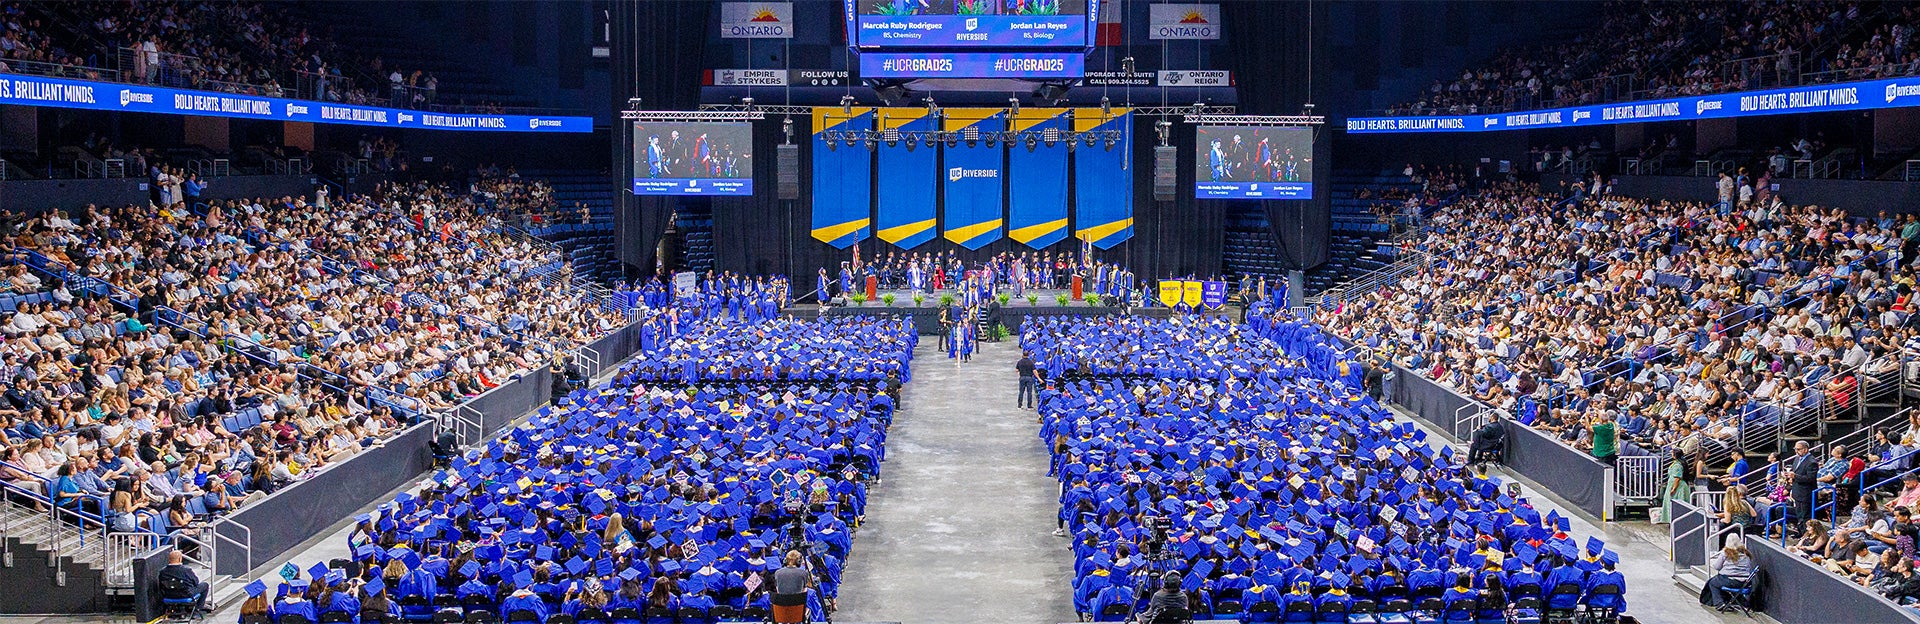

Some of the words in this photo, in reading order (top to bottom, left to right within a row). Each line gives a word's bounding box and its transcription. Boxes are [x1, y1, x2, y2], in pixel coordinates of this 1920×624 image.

[731, 26, 783, 35] ONTARIO
[890, 22, 908, 31] Ruby
[909, 22, 942, 31] Rodriguez
[1010, 22, 1032, 30] Jordan
[1050, 22, 1067, 31] Reyes
[893, 32, 921, 40] Chemistry
[1033, 32, 1055, 40] Biology
[1159, 27, 1210, 36] ONTARIO
[956, 33, 988, 41] RIVERSIDE
[883, 59, 952, 71] #UCRGRAD25
[994, 59, 1063, 71] #UCRGRAD25
[15, 80, 63, 101] BRILLIANT
[65, 85, 96, 104] MINDS.
[1740, 96, 1758, 112] BOLD
[1759, 93, 1788, 110] HEARTS.
[1789, 89, 1828, 108] BRILLIANT
[1829, 87, 1859, 105] MINDS.
[175, 94, 193, 110] BOLD
[194, 96, 221, 112] HEARTS.
[222, 97, 251, 114] BRILLIANT
[252, 100, 272, 116] MINDS.
[478, 118, 506, 128] MINDS.
[1347, 120, 1365, 130] BOLD
[1367, 119, 1397, 130] HEARTS.
[1398, 119, 1436, 130] BRILLIANT
[1437, 118, 1465, 129] MINDS.
[951, 169, 961, 177] UC
[963, 169, 998, 177] RIVERSIDE
